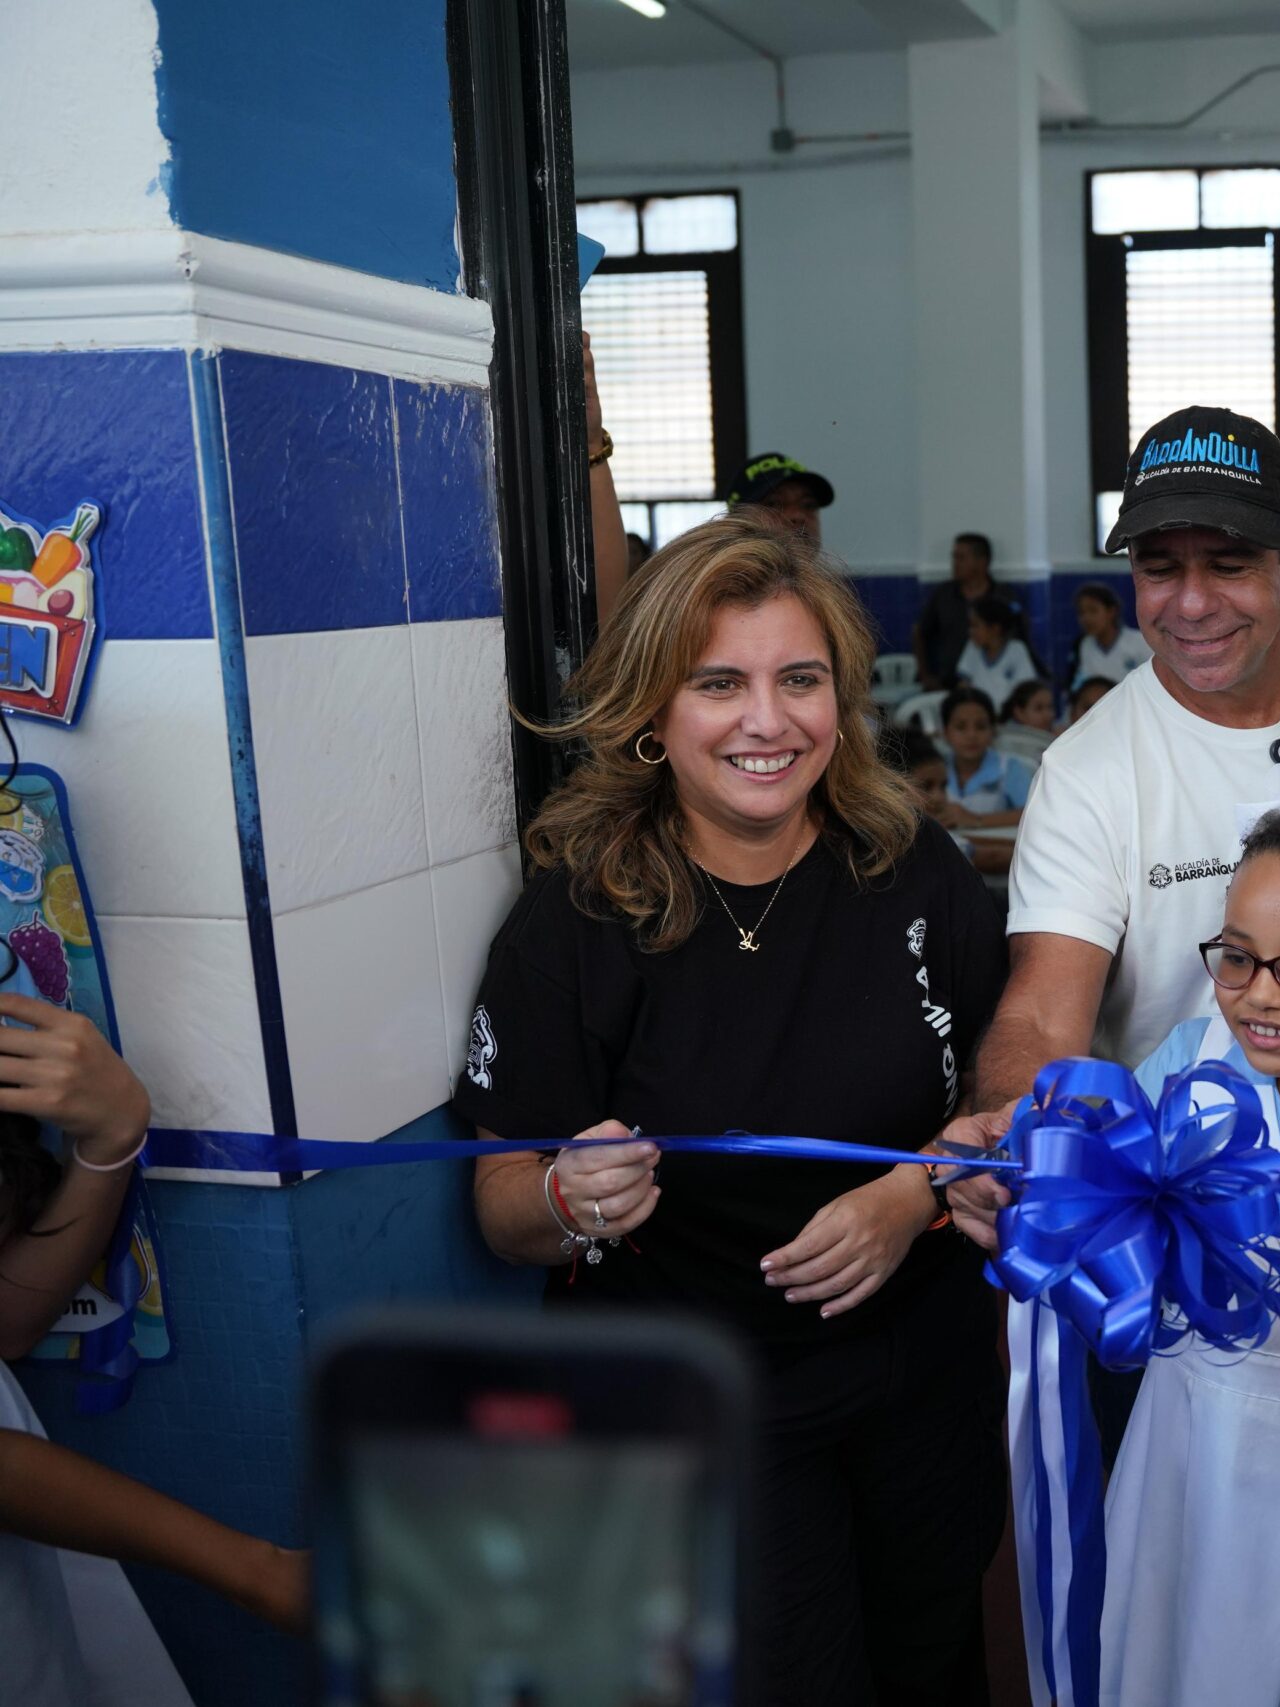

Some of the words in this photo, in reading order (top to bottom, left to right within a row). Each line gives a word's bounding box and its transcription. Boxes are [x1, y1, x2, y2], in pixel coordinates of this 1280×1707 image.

[1183, 466, 1262, 485] BARRANQUILLA
[1174, 857, 1210, 872] ALCALDÍA
[1211, 857, 1221, 866] DE
